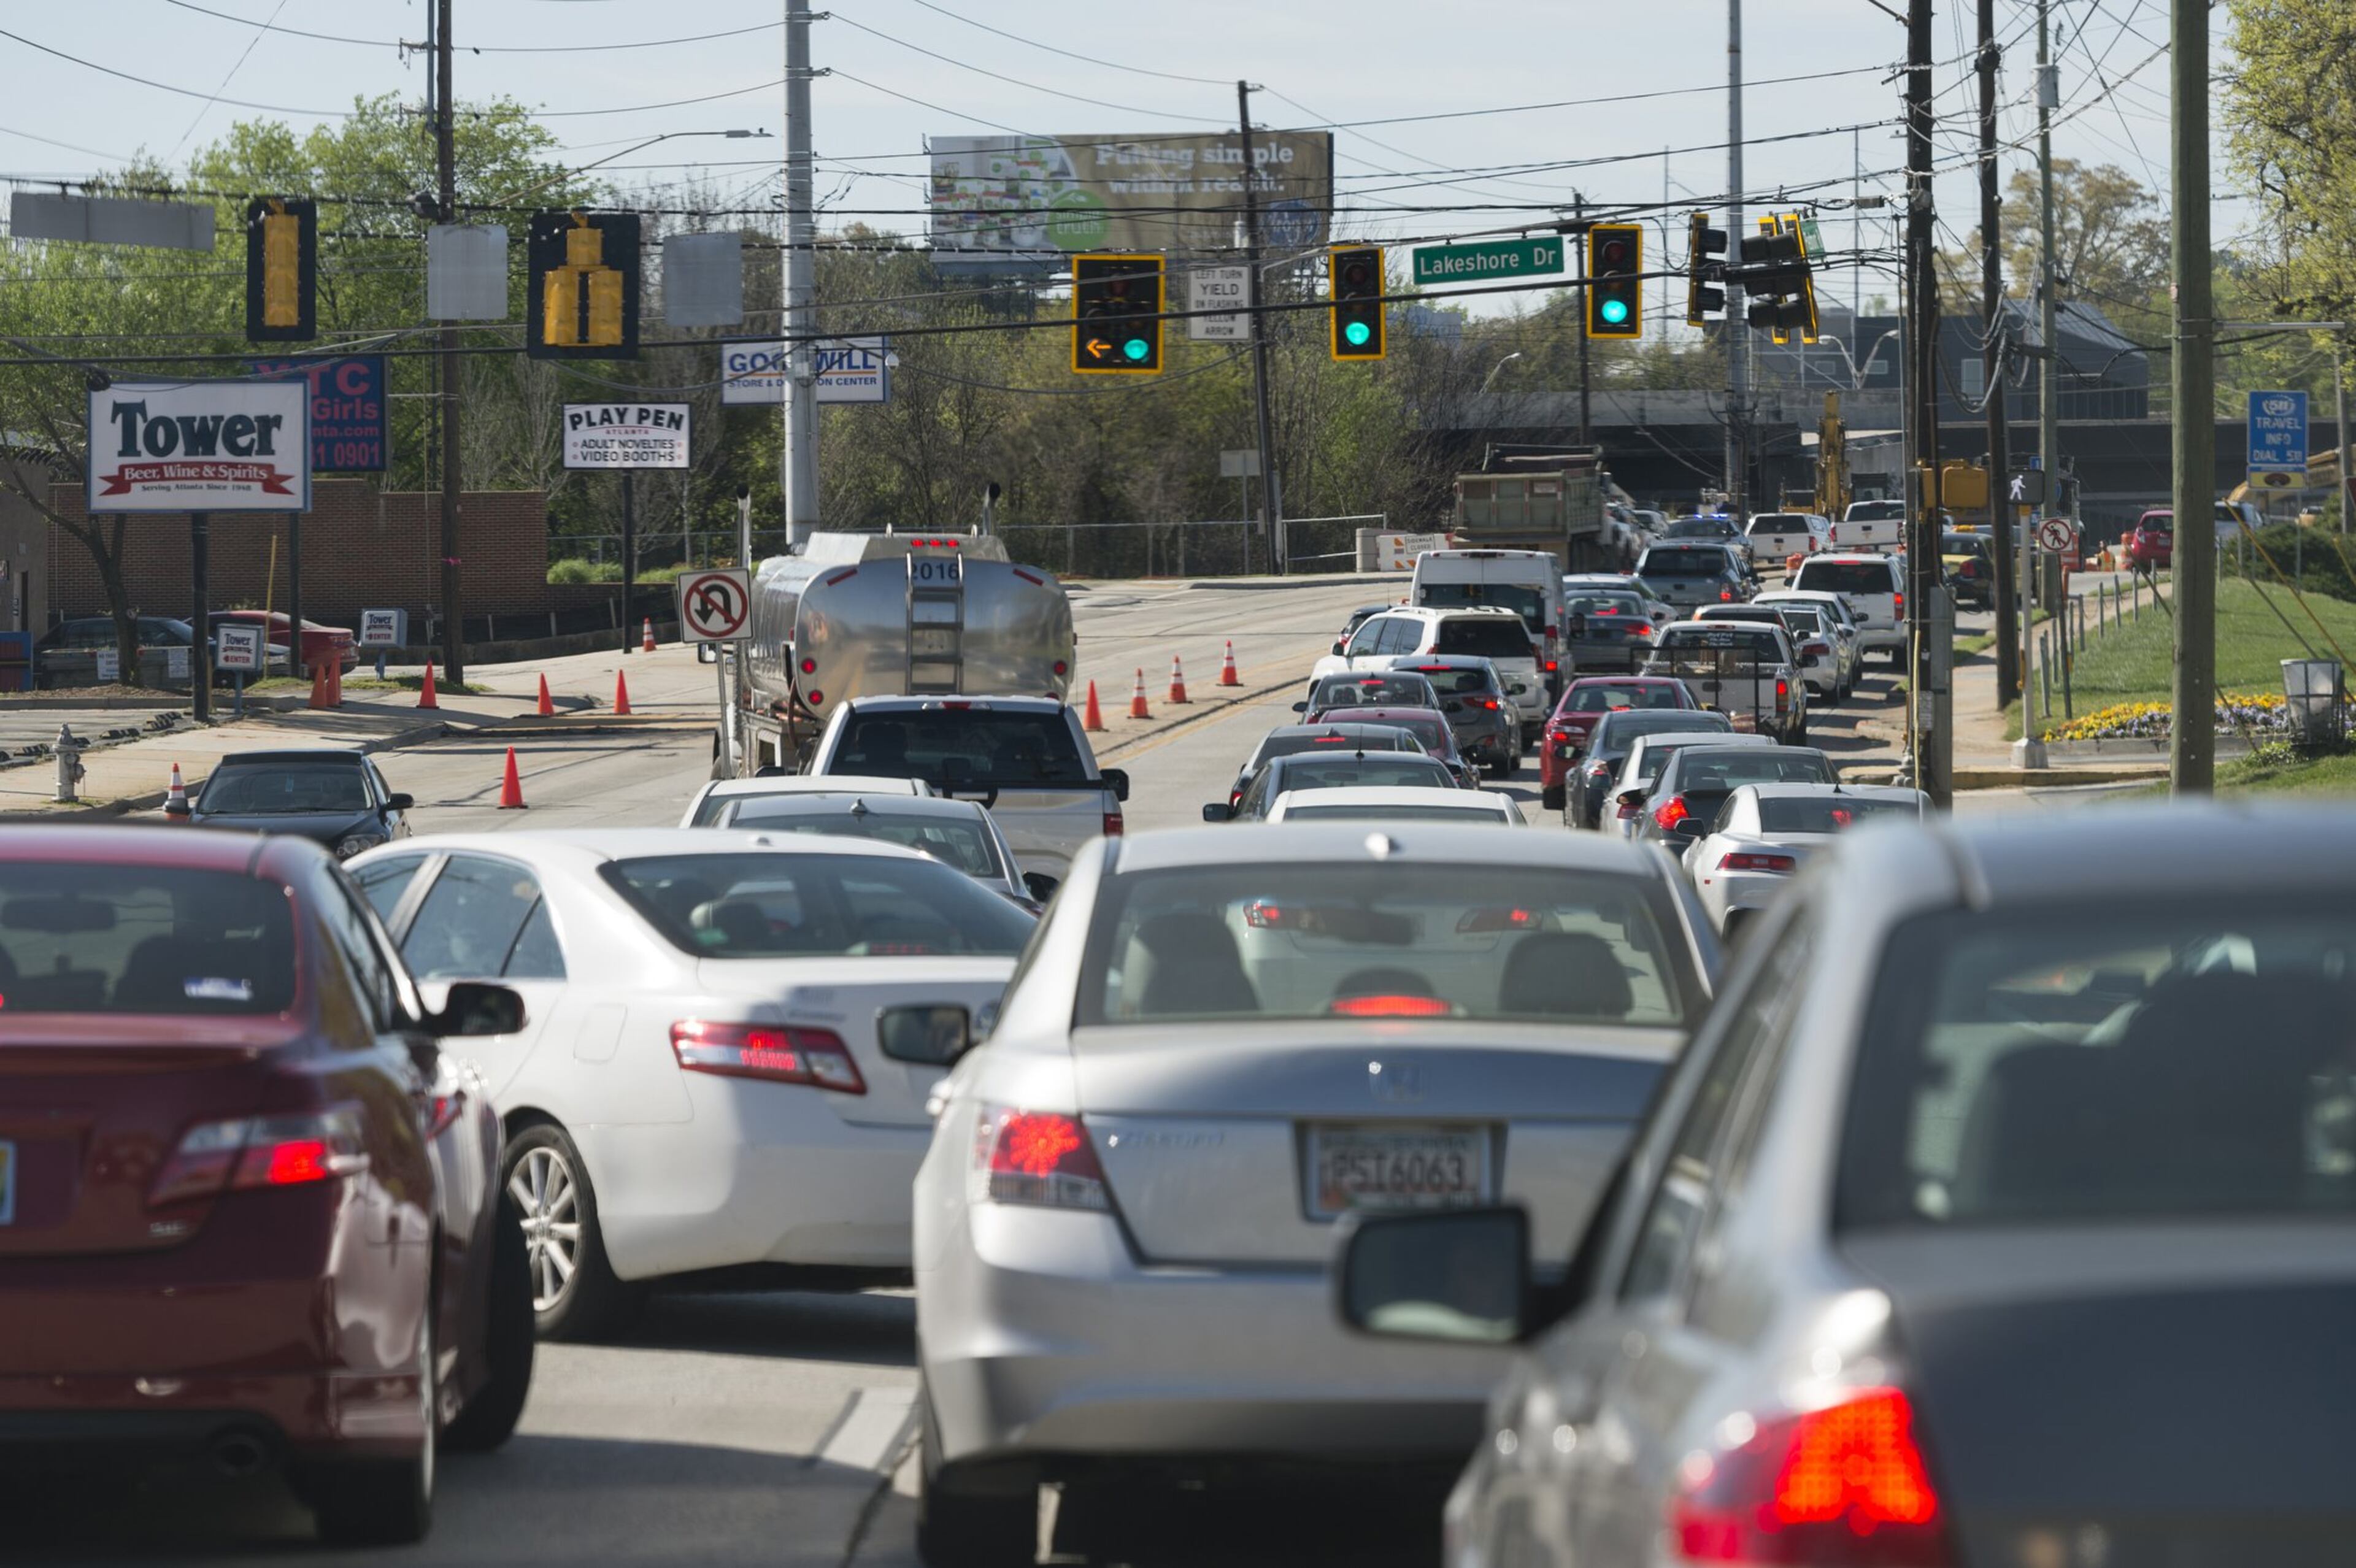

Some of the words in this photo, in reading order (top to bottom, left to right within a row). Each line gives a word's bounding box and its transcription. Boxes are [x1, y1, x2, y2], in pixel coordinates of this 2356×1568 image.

[1203, 142, 1293, 167] simple
[1109, 171, 1195, 193] within
[1420, 253, 1520, 275] Lakeshore
[1533, 248, 1556, 266] Dr
[1196, 270, 1215, 279] LEFT
[1220, 270, 1243, 279] TURN
[1201, 283, 1239, 295] YIELD
[1208, 299, 1244, 308] FLASHING
[1204, 313, 1236, 322] YELLOW
[728, 379, 763, 388] STORE
[836, 377, 877, 386] CENTER
[312, 398, 379, 420] Girls
[569, 407, 629, 431] PLAY
[637, 407, 684, 431] PEN
[2255, 417, 2302, 429] TRAVEL
[111, 398, 283, 458] Tower
[580, 439, 615, 449] ADULT
[618, 439, 674, 449] NOVELTIES
[2265, 432, 2292, 445] INFO
[334, 441, 379, 466] 0901
[580, 451, 618, 461] VIDEO
[623, 451, 674, 461] BOOTHS
[2253, 450, 2279, 461] DIAL
[124, 467, 160, 480] Beer,
[163, 464, 200, 478] Wine
[202, 464, 216, 477] &
[218, 464, 268, 480] Spirits
[906, 563, 960, 580] 2016
[369, 614, 392, 624] Tower
[225, 633, 251, 646] Tower
